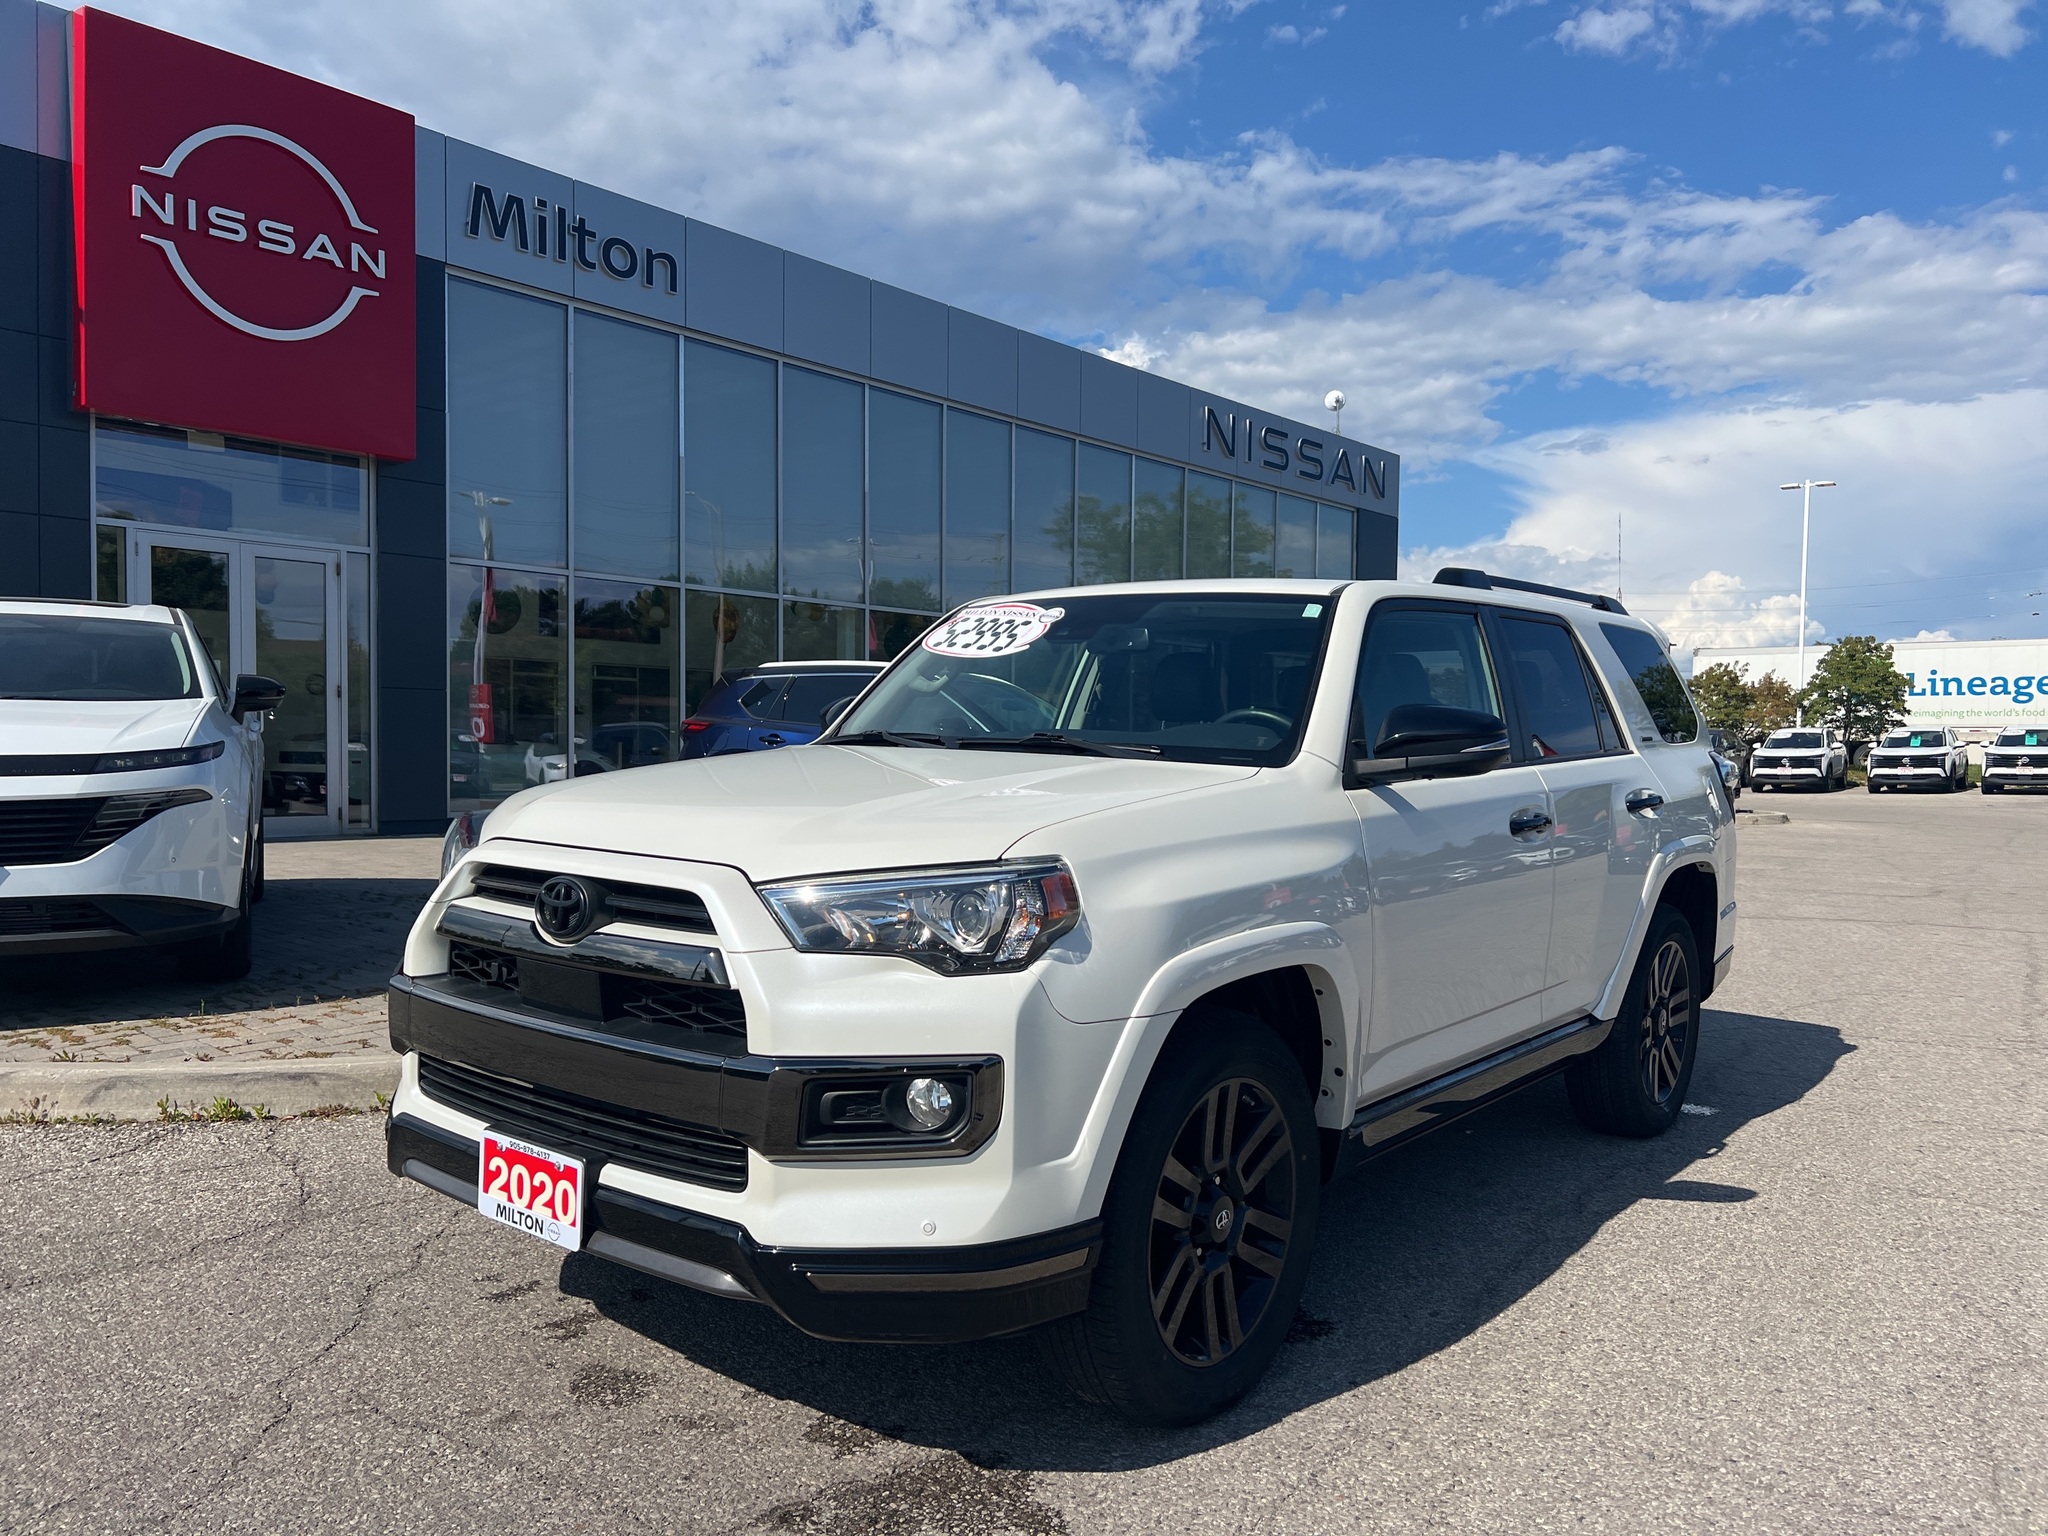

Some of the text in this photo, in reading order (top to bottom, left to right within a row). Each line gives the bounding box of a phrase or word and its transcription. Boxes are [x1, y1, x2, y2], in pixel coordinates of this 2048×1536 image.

[132, 184, 386, 279] NISSAN
[467, 182, 679, 294] Milton
[1203, 405, 1386, 500] NISSAN
[1001, 610, 1038, 618] NISSAN
[1904, 669, 2048, 704] Lineage
[1966, 708, 1985, 717] the
[1985, 708, 2020, 717] world's
[2022, 707, 2046, 717] food
[509, 1141, 550, 1159] 905-878-4137
[487, 1156, 576, 1225] 2020
[495, 1203, 544, 1235] MILTON
